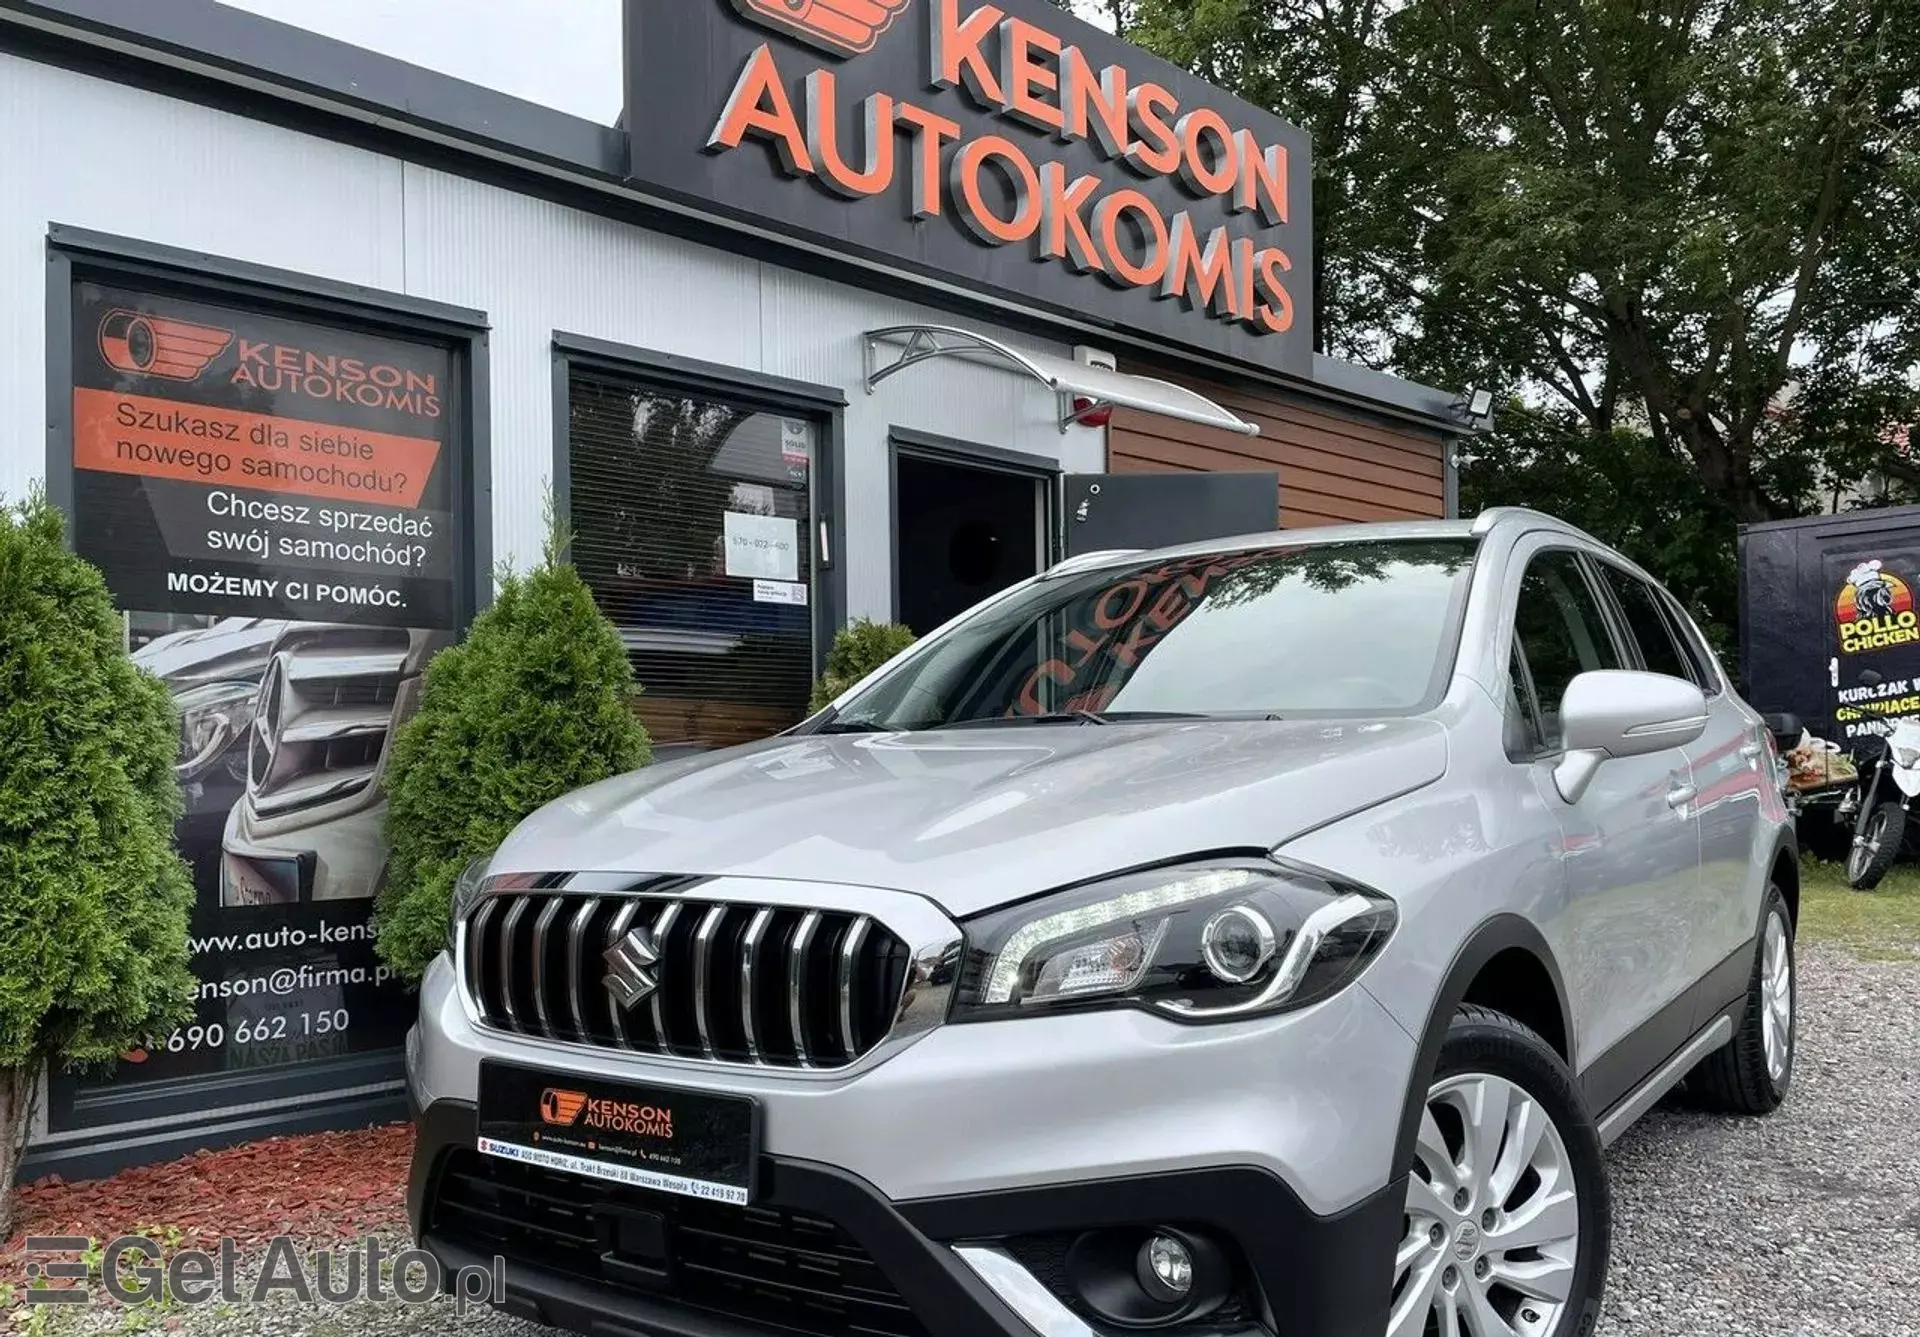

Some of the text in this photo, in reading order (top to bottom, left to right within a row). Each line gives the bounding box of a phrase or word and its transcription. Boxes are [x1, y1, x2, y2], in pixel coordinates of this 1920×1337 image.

[930, 0, 1288, 227] KENSON
[706, 43, 1294, 335] AUTOKOMIS
[238, 338, 436, 395] KENSON
[230, 365, 441, 418] AUTOKOMIS
[116, 403, 375, 460] Szukasz dla siebie
[116, 439, 408, 493] nowego samochodu?
[207, 491, 433, 538] Chcesz sprzedać
[207, 529, 426, 567] swój samochód?
[167, 571, 408, 608] MOŻEMY CI POMÓC.
[1839, 610, 1917, 640] POLLO
[1842, 627, 1919, 653] CHICKEN
[186, 920, 377, 953] ww.auto-kens
[167, 1008, 349, 1054] 690 662 150
[584, 1113, 673, 1139] AUTOKOMIS
[588, 1099, 672, 1123] KENSON
[489, 1142, 520, 1158] SUZUKI
[580, 1161, 597, 1174] Trakt
[700, 1184, 710, 1197] 22
